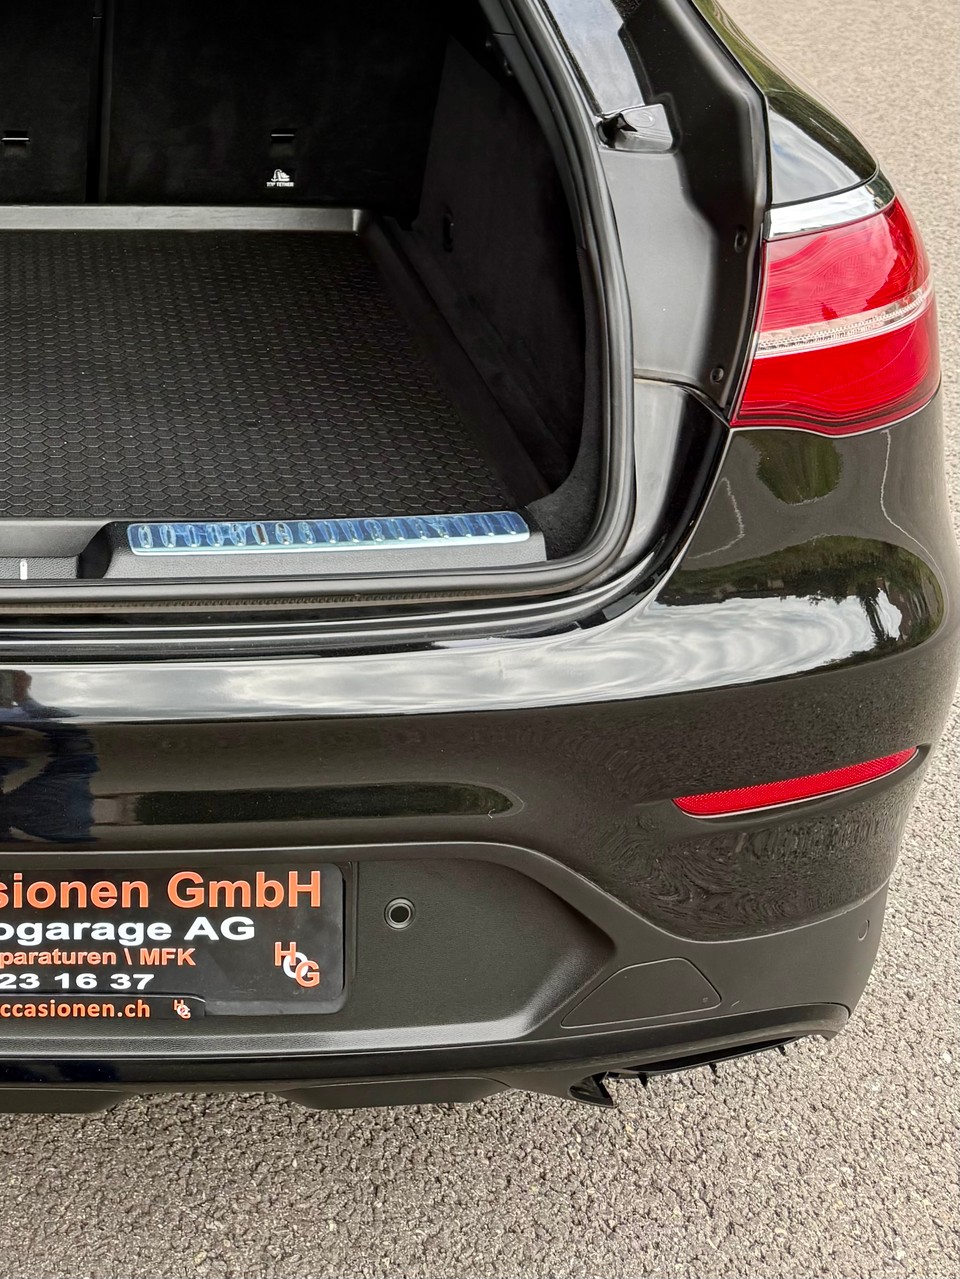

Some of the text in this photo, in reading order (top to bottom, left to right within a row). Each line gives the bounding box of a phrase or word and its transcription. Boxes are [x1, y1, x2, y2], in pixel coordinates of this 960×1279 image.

[167, 871, 321, 909] GmbH
[184, 916, 255, 941] AG
[139, 948, 196, 966] MFK
[55, 973, 98, 990] 16
[110, 973, 155, 990] 37
